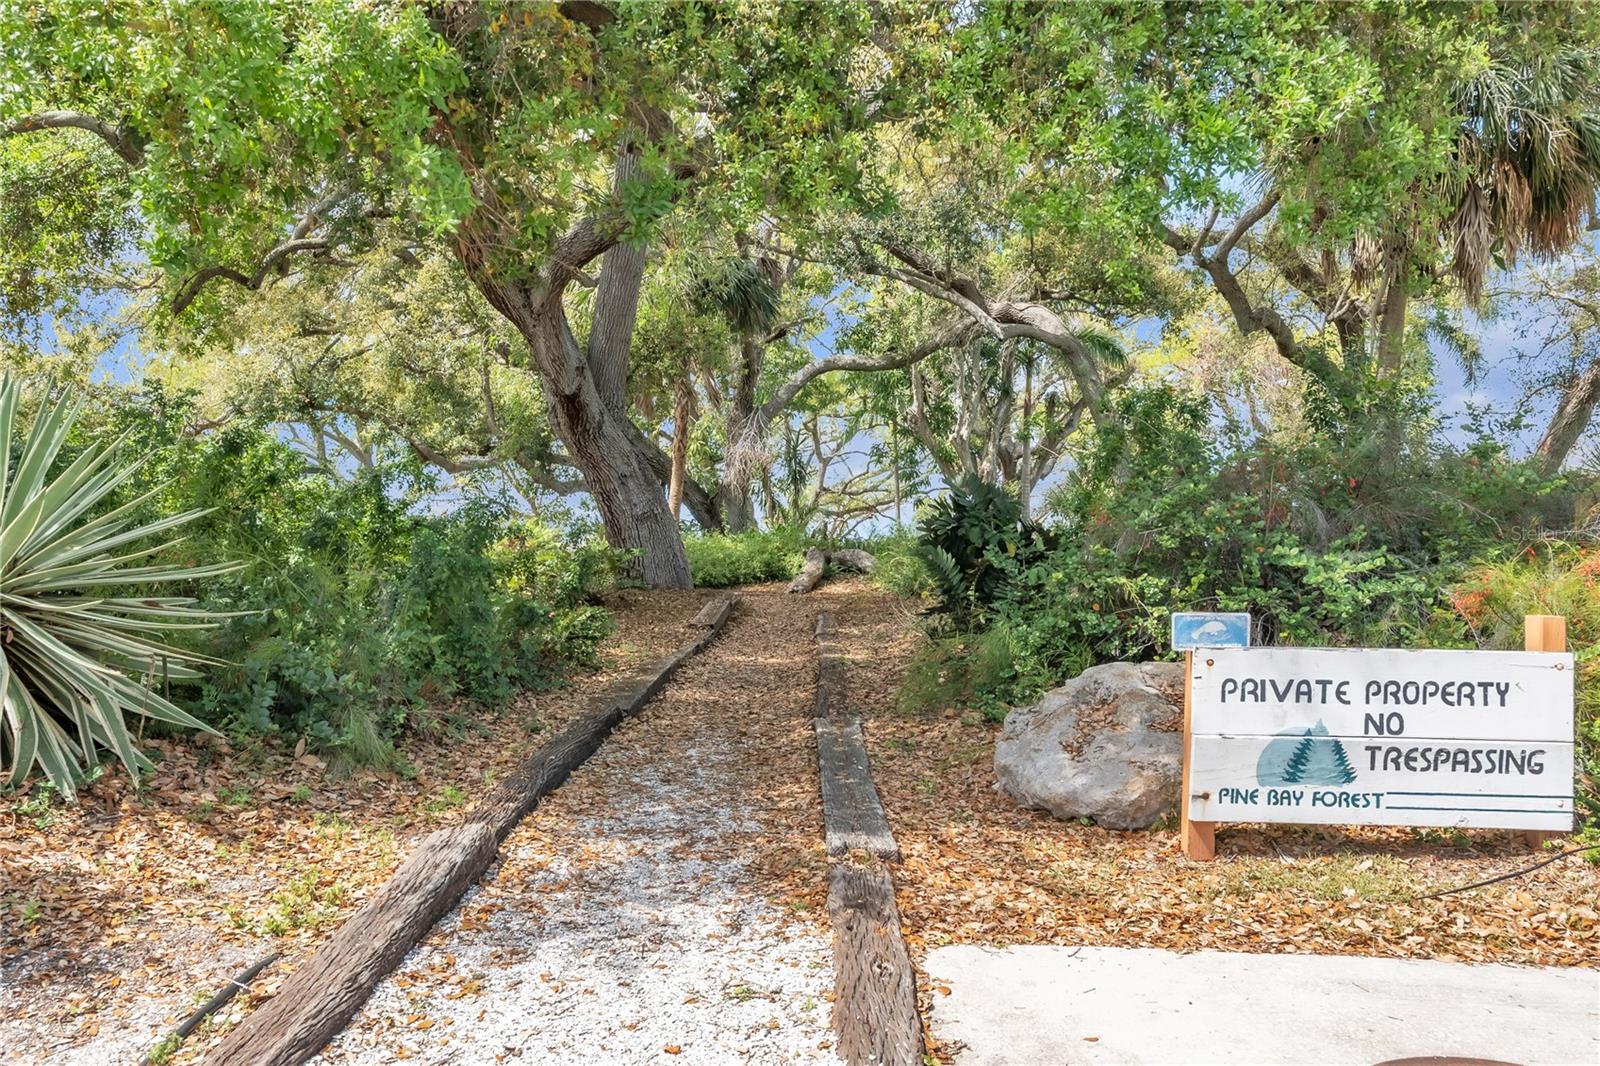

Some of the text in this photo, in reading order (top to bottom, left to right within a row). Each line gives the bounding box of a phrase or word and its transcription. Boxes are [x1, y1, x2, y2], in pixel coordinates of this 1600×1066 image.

[1220, 678, 1510, 707] PRIVATE PROPERTY
[1364, 711, 1404, 736] NO
[1365, 745, 1546, 774] TRESPASSING
[1218, 787, 1385, 809] PINE BAY FOREST
